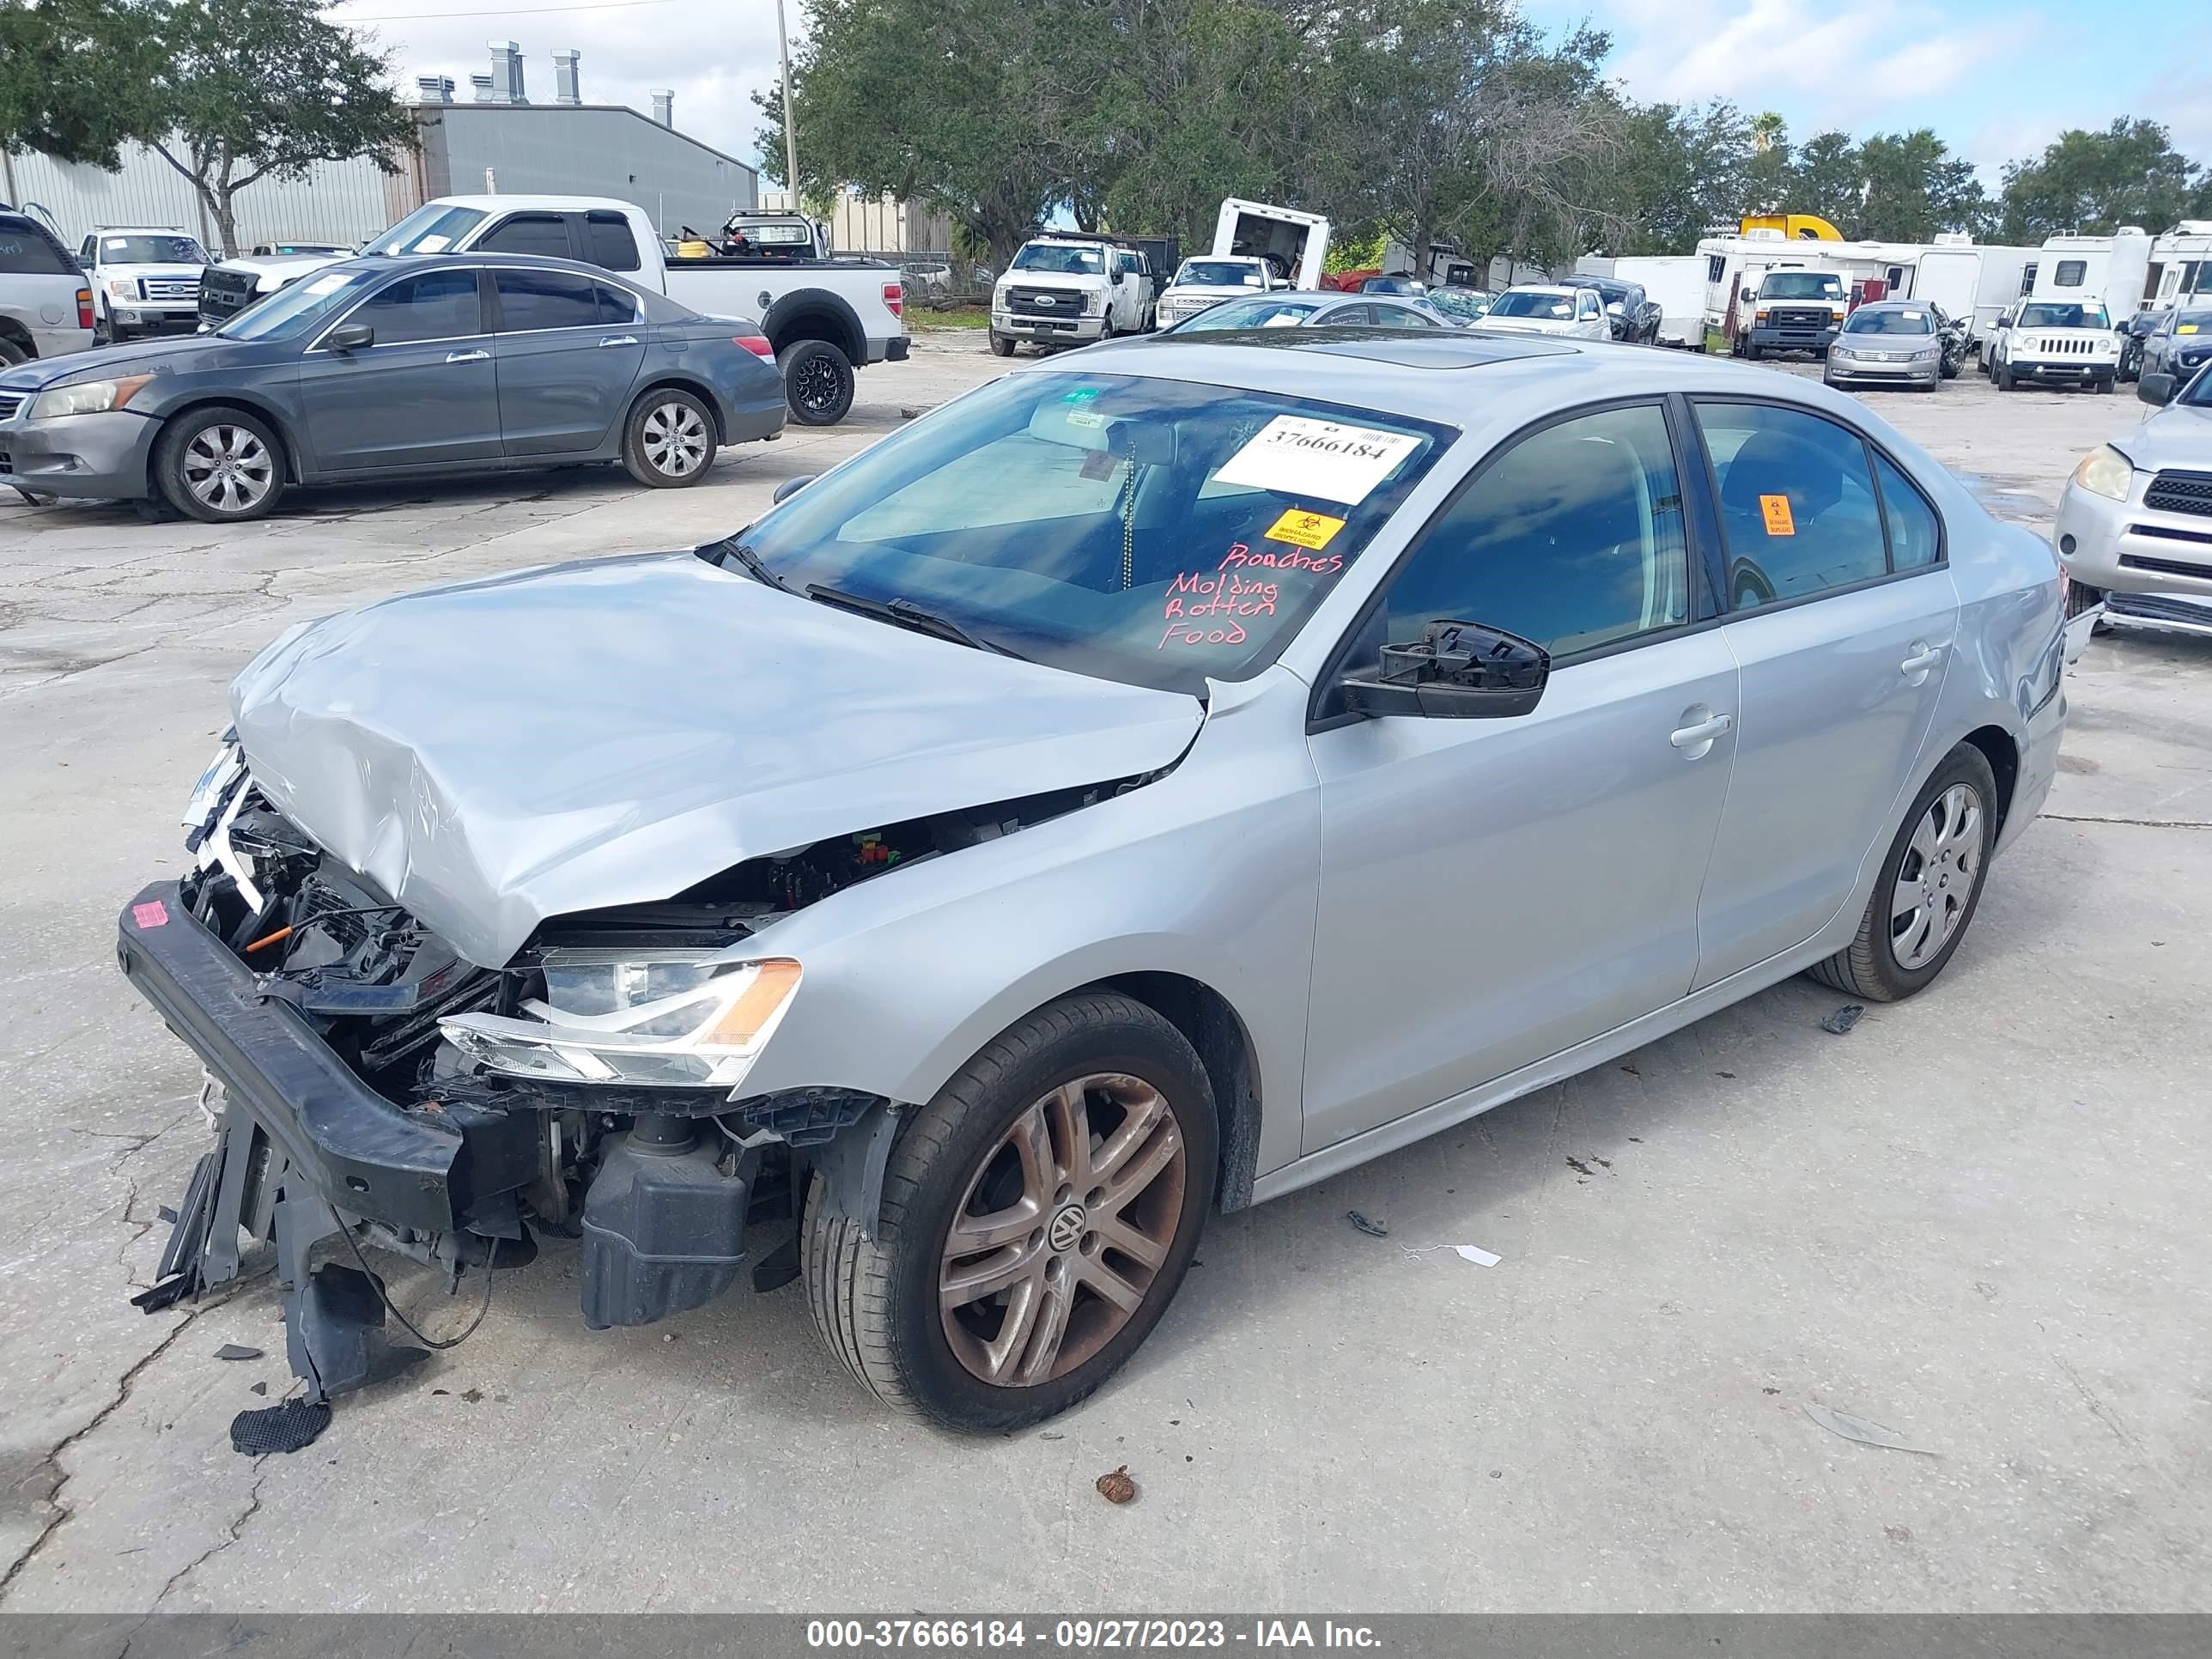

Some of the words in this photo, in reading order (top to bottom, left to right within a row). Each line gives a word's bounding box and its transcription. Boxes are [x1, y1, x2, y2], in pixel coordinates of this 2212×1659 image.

[1267, 431, 1388, 460] 37666184
[1278, 526, 1322, 541] BIOHAZARD
[1218, 542, 1345, 574] Roaches
[1165, 572, 1279, 602] Molding
[1164, 594, 1277, 619] Rotten
[1158, 620, 1248, 650] Food
